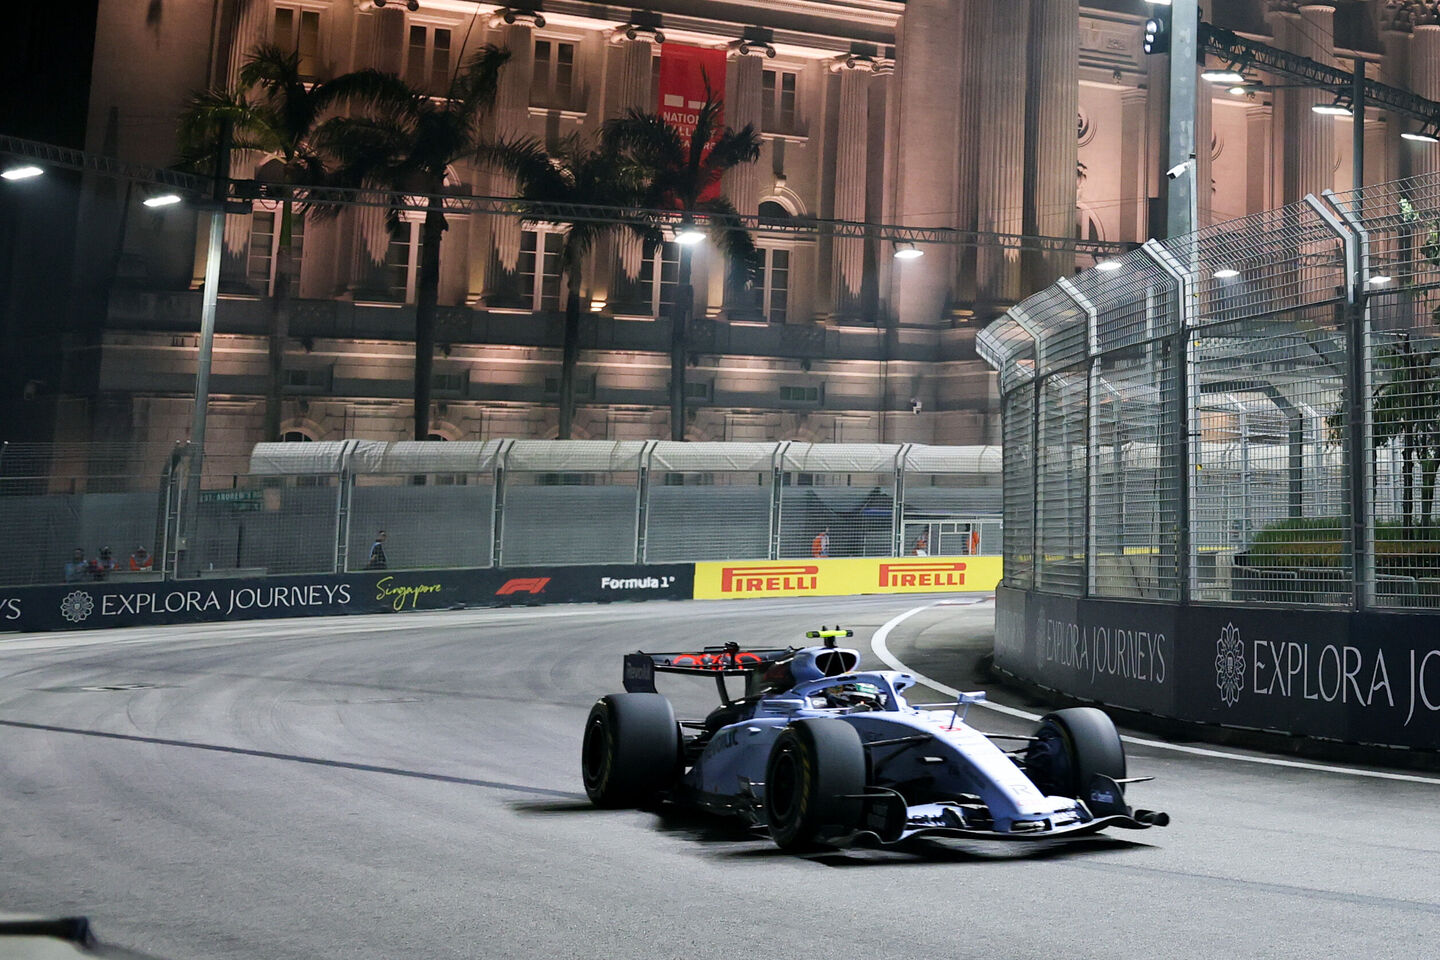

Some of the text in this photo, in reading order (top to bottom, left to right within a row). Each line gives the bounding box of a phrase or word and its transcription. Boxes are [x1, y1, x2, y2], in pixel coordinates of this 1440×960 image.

[601, 576, 659, 589] Formula
[721, 565, 818, 592] PIRELLI
[879, 562, 967, 587] PIRELLI
[102, 584, 351, 615] EXPLORA JOURNEYS
[376, 576, 441, 611] Singapore
[1046, 619, 1089, 670] EXPLORA
[1090, 626, 1166, 684] JOURNEYS
[1254, 640, 1395, 707] EXPLORA
